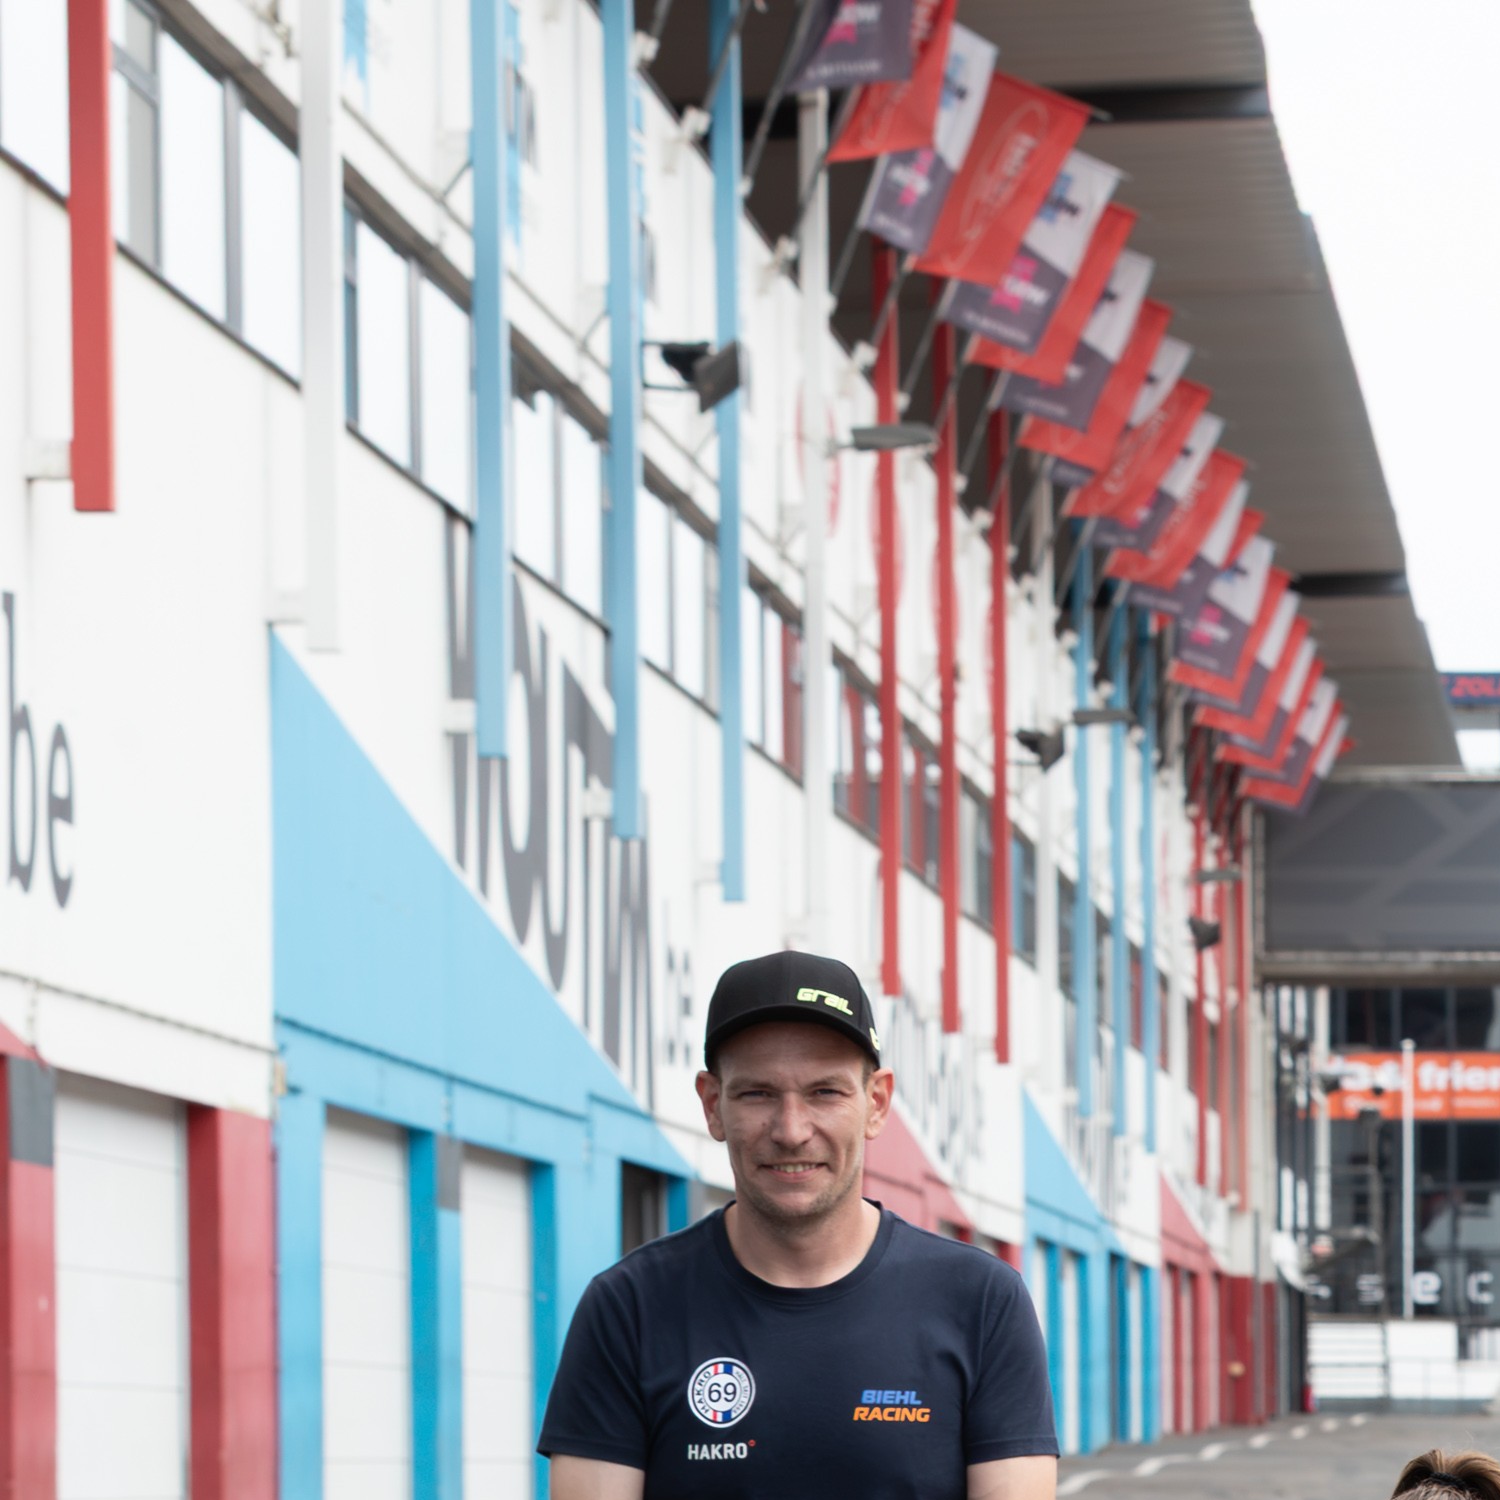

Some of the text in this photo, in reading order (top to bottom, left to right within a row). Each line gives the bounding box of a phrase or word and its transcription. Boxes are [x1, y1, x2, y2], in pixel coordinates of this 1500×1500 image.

[708, 1382, 737, 1403] 69
[860, 1389, 922, 1405] BIEHL
[852, 1406, 931, 1423] RACING
[687, 1442, 748, 1460] HAKRO
